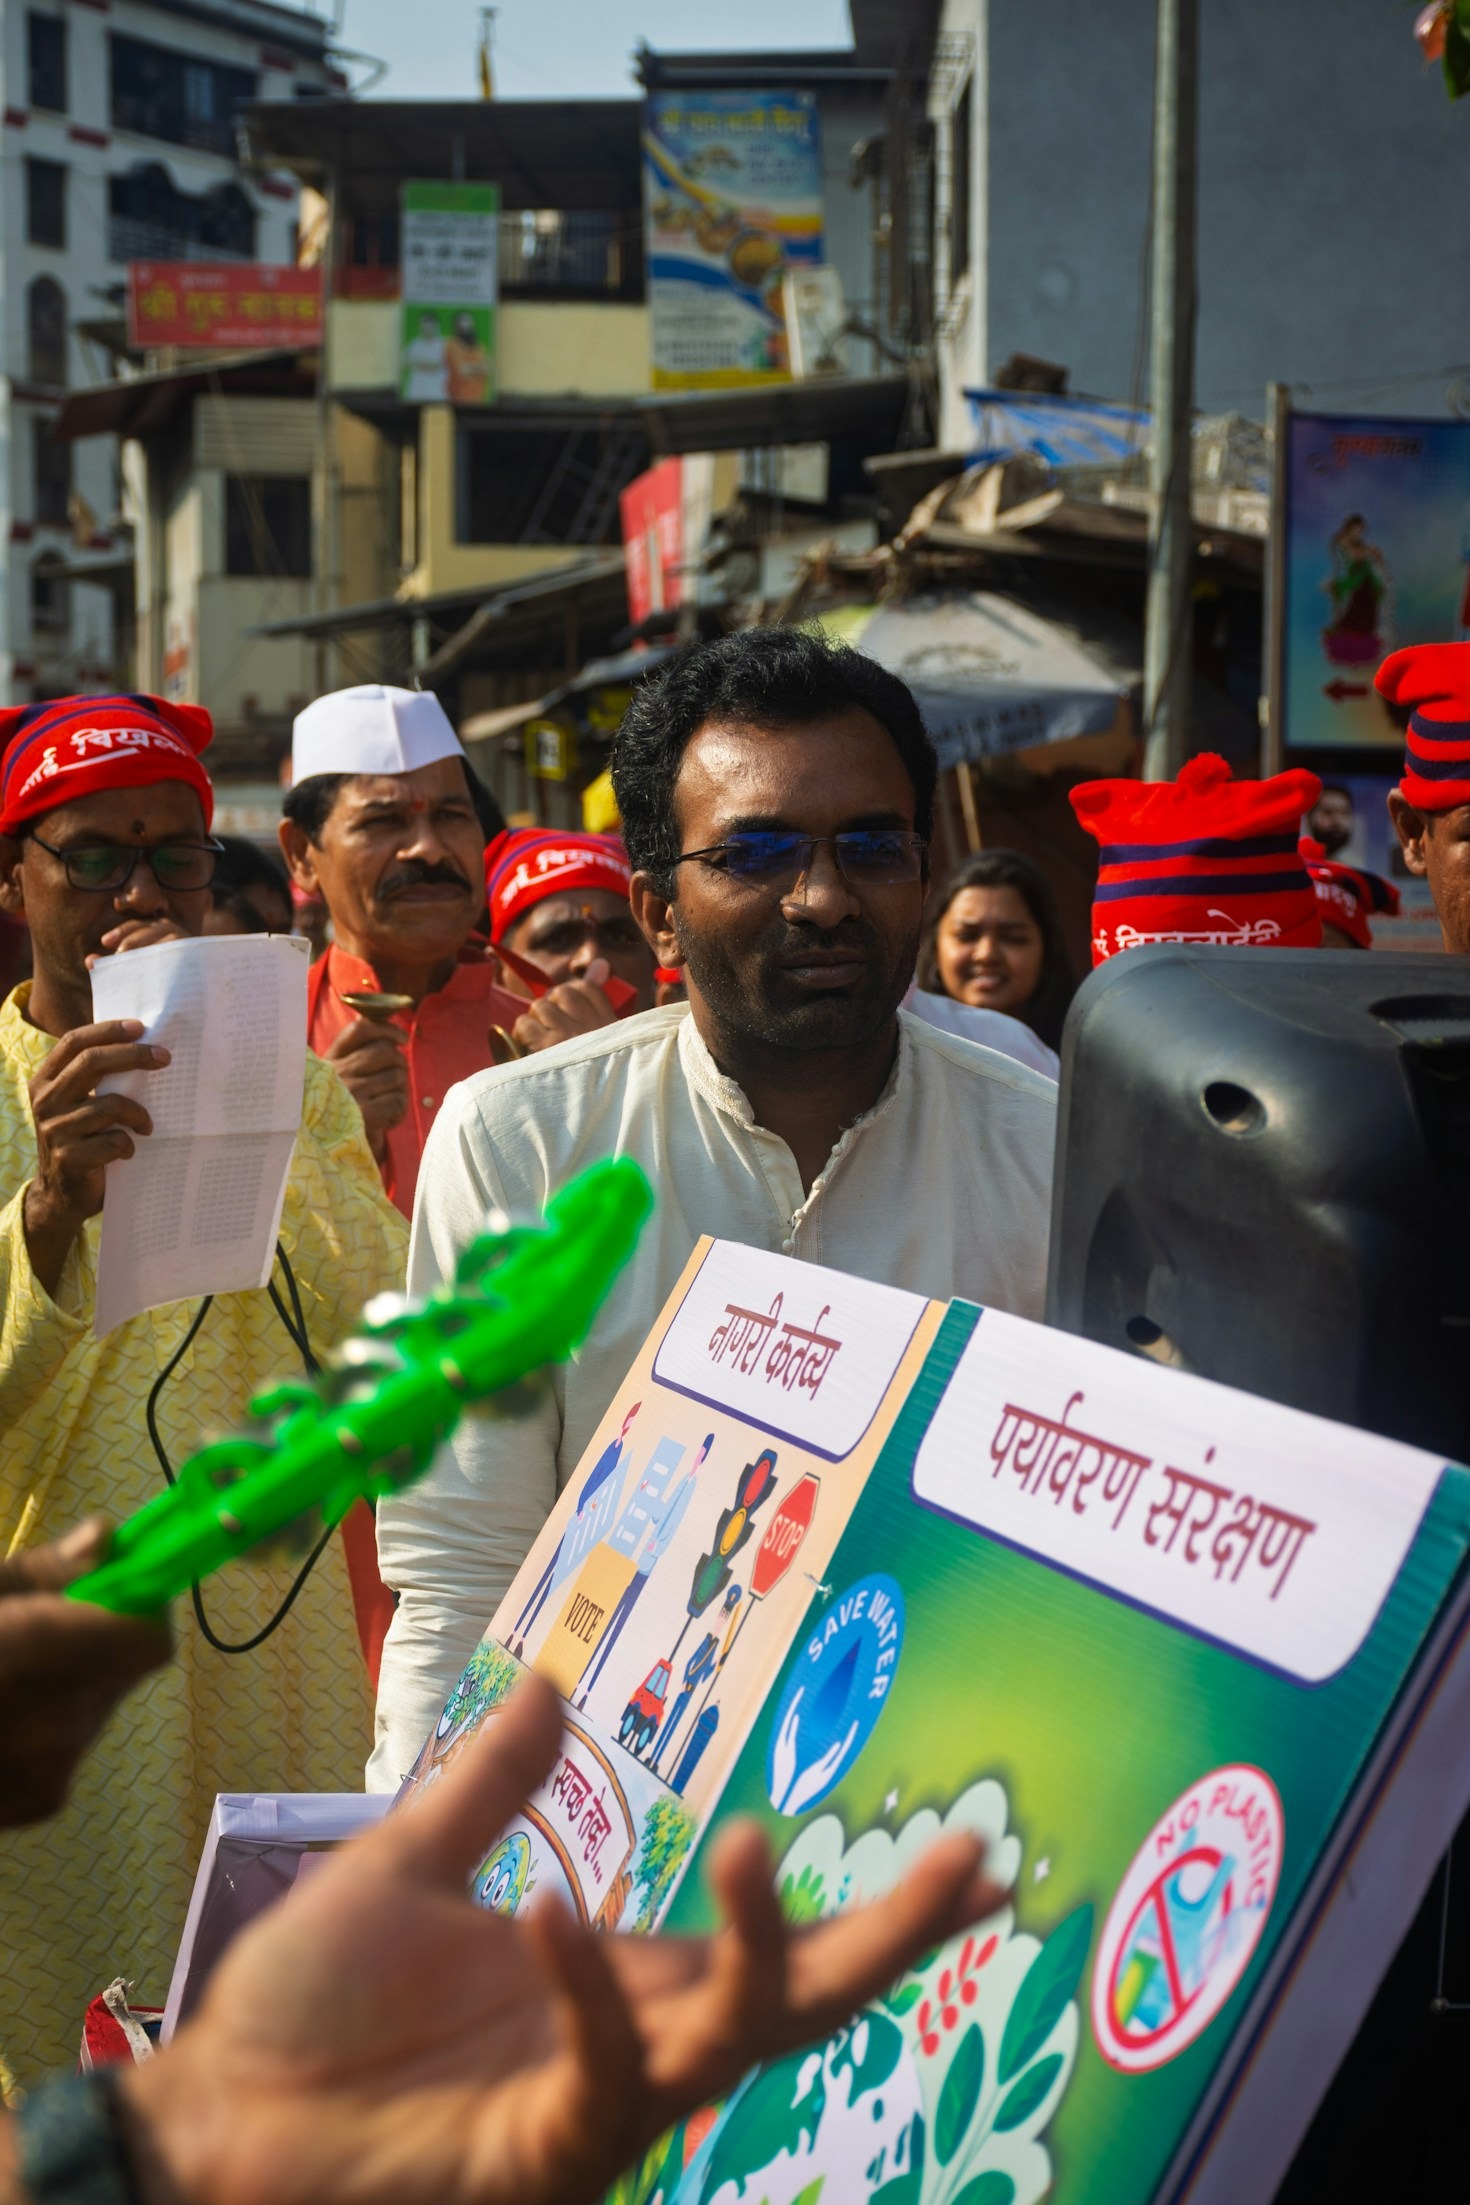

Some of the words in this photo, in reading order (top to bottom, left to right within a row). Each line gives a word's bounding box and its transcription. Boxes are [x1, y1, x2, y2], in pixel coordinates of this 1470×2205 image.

[708, 1291, 784, 1377] नागरी
[765, 1305, 842, 1401] कर्तव्य
[991, 1391, 1153, 1530] पर्यावरण
[763, 1513, 805, 1560] STOP
[564, 1592, 605, 1645] VOTE
[808, 1590, 869, 1664] SAVE
[867, 1589, 897, 1700] WATER
[550, 1758, 593, 1822] स्वच्छ
[1156, 1798, 1200, 1859] NO
[1207, 1783, 1271, 1908] PLASTIC
